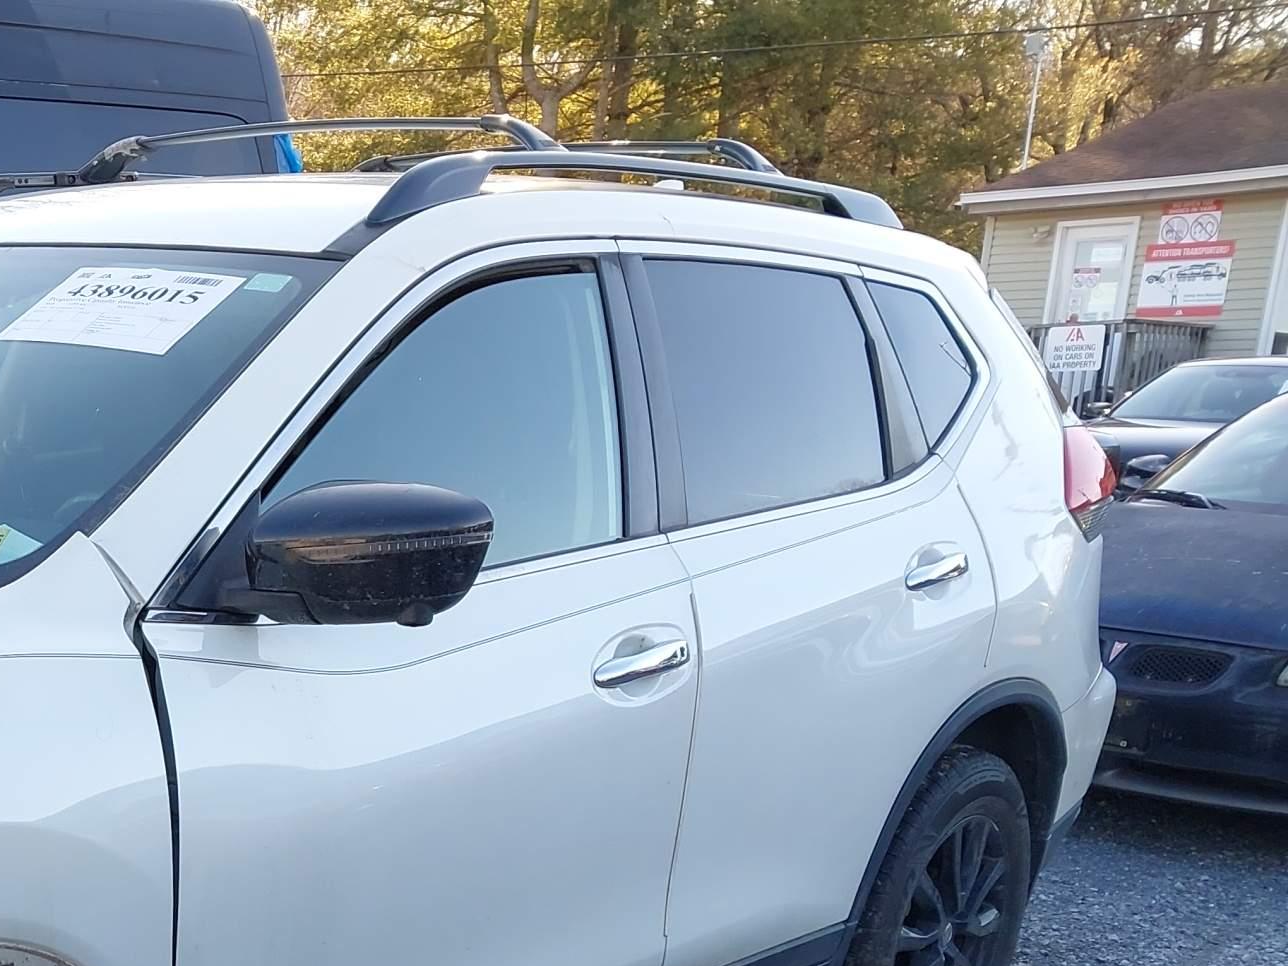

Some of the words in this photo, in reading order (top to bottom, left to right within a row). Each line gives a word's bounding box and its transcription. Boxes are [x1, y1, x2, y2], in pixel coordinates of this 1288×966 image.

[68, 283, 206, 305] 43896015
[1053, 344, 1063, 353] NO
[1065, 343, 1097, 353] WORKING
[1053, 353, 1063, 361] ON
[1064, 352, 1083, 361] CARS
[1084, 351, 1095, 360] ON
[1062, 360, 1097, 369] PROPERTY
